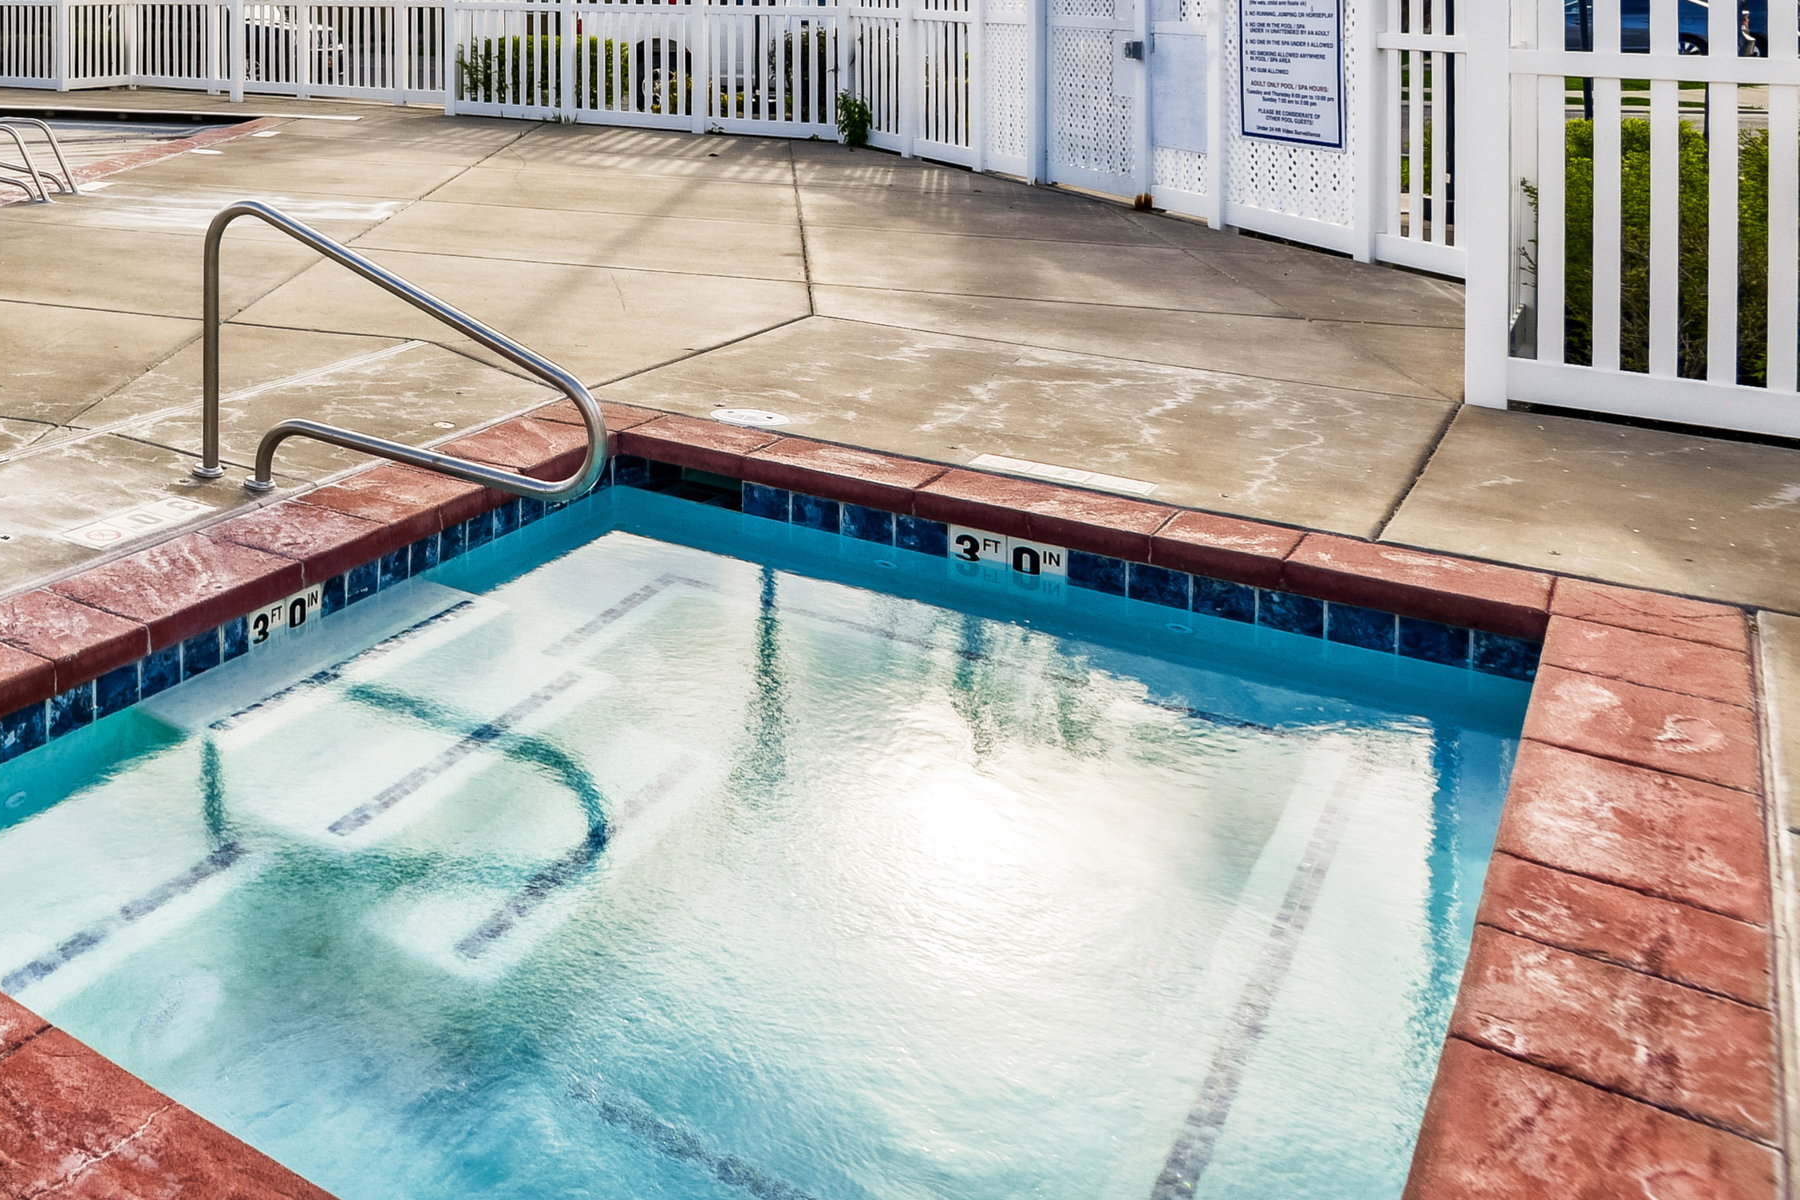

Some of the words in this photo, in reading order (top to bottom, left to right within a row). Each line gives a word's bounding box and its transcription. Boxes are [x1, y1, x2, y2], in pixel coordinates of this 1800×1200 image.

[955, 534, 980, 562] 3
[983, 538, 1000, 553] FT
[1012, 546, 1040, 575] 0
[1043, 551, 1060, 567] IN
[253, 613, 269, 644] 3
[271, 605, 282, 623] FT
[289, 598, 306, 628] 0
[308, 590, 318, 608] IN
